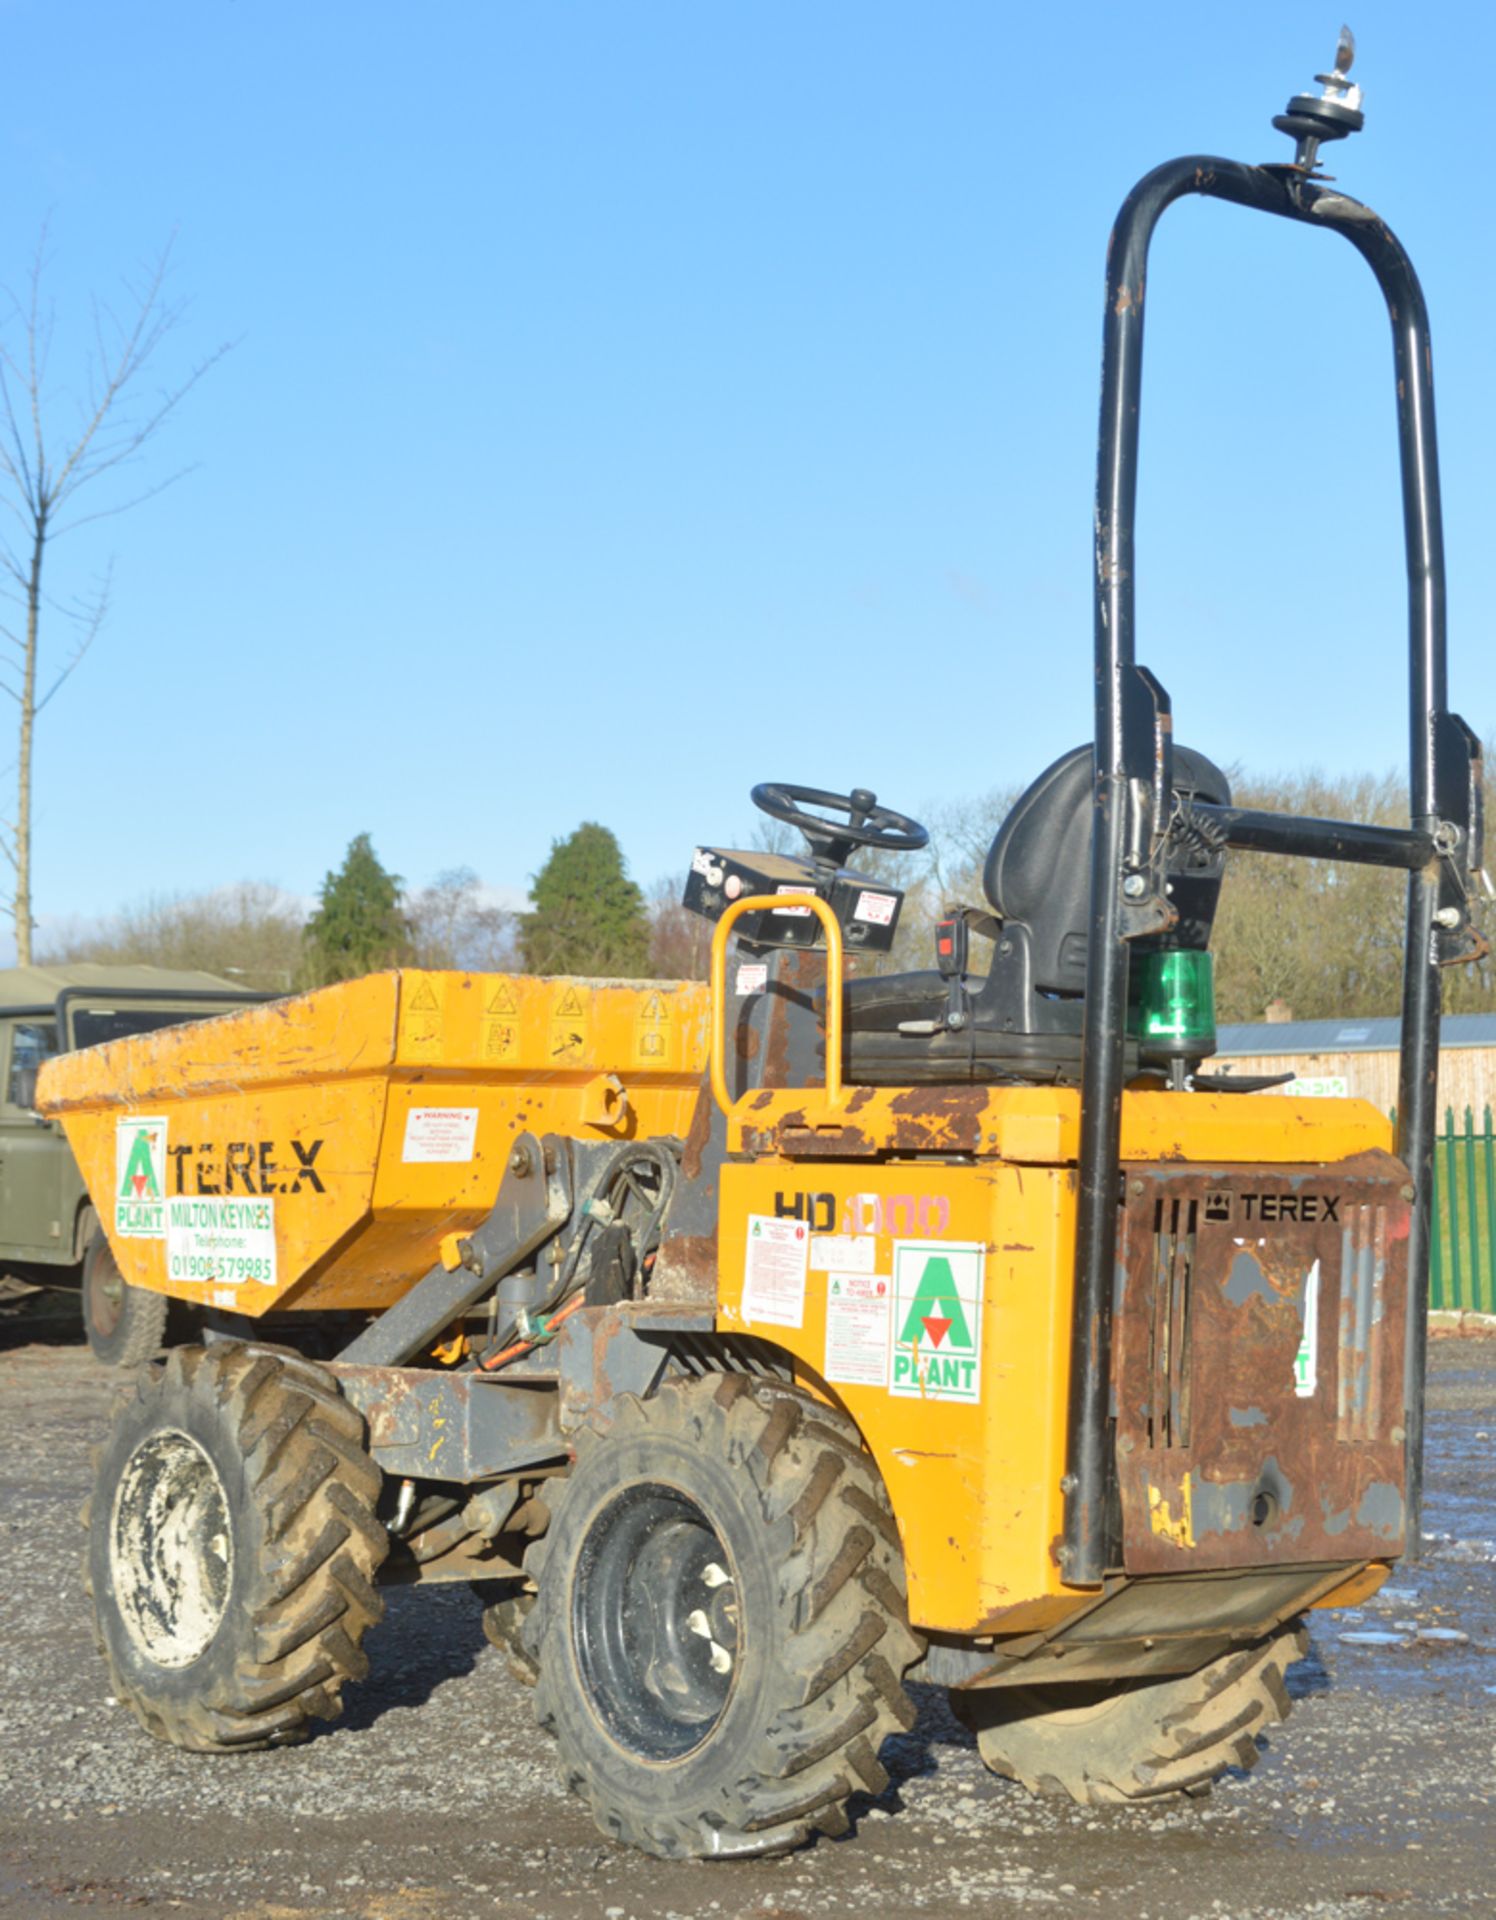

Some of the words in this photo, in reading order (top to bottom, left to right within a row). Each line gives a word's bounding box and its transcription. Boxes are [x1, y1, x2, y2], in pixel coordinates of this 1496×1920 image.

[167, 1140, 326, 1194] TEREX
[117, 1205, 163, 1228] PLANT
[170, 1203, 219, 1228] MILTON
[220, 1204, 271, 1230] KEYNES
[775, 1192, 836, 1231] HD
[1240, 1194, 1341, 1222] TEREX
[900, 1257, 972, 1348] A
[894, 1354, 976, 1388] PLANT
